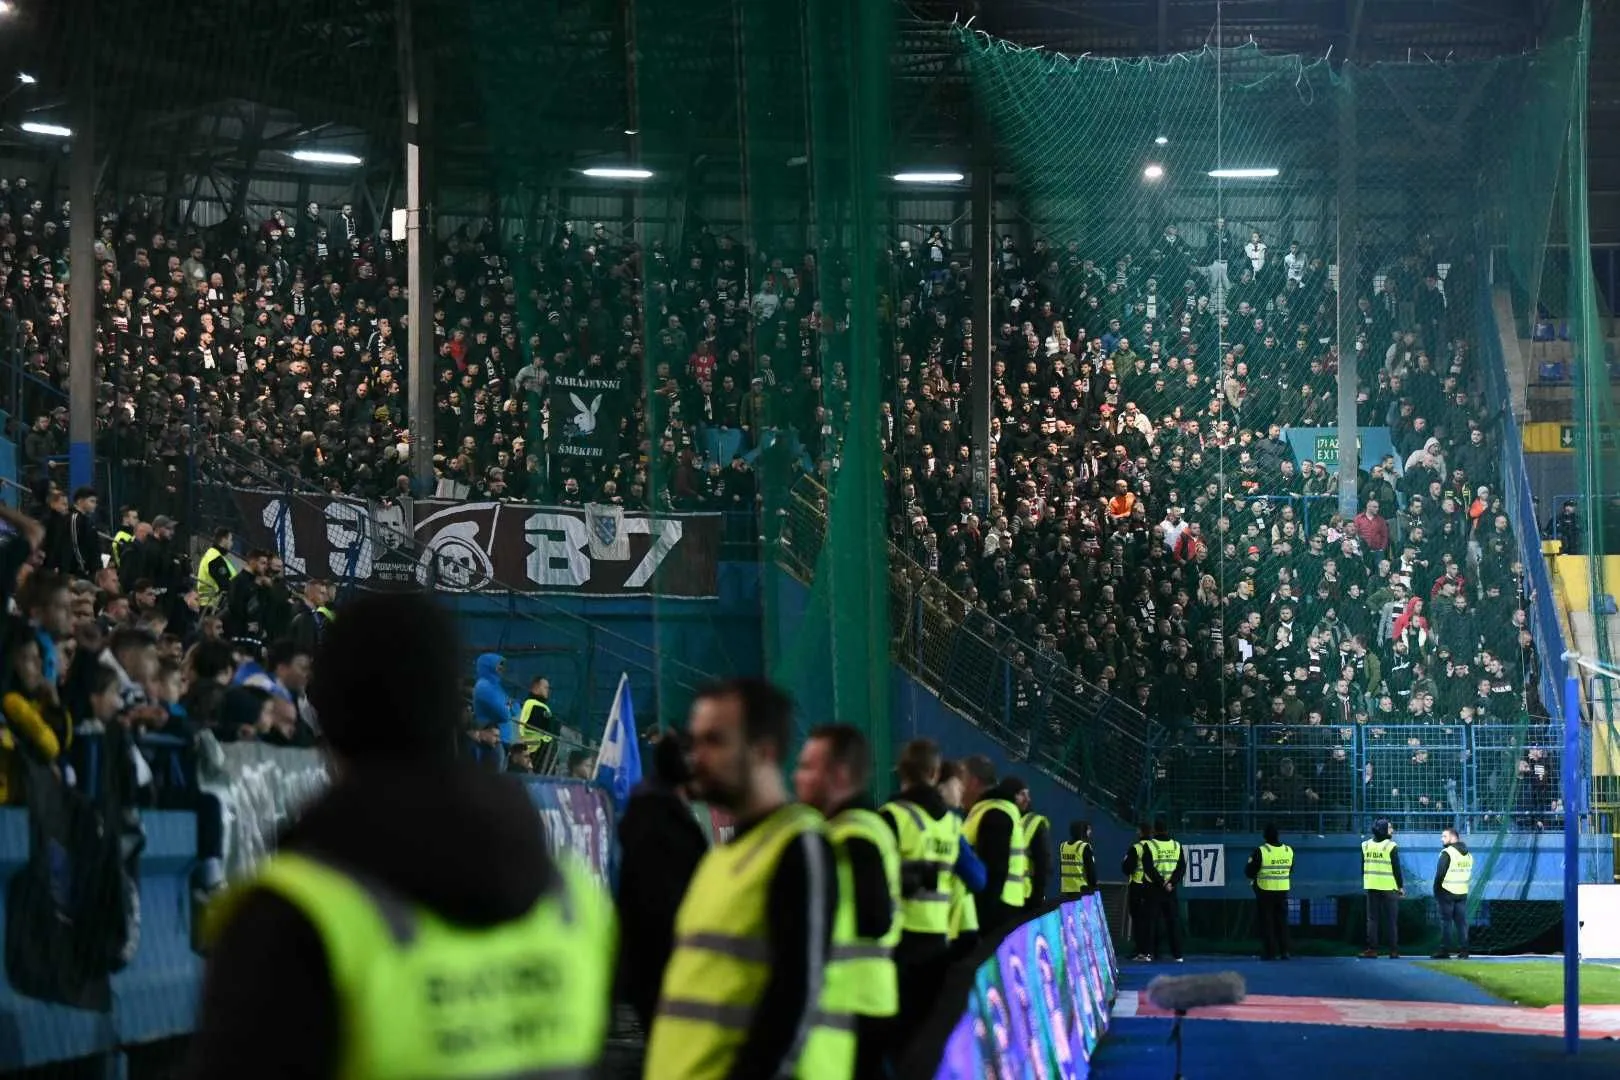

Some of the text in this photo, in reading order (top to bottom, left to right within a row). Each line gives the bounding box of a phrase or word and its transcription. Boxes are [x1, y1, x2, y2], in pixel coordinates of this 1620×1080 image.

[555, 375, 620, 389] SARAJEVSKI
[1317, 450, 1340, 460] EXIT
[1190, 848, 1219, 882] 87
